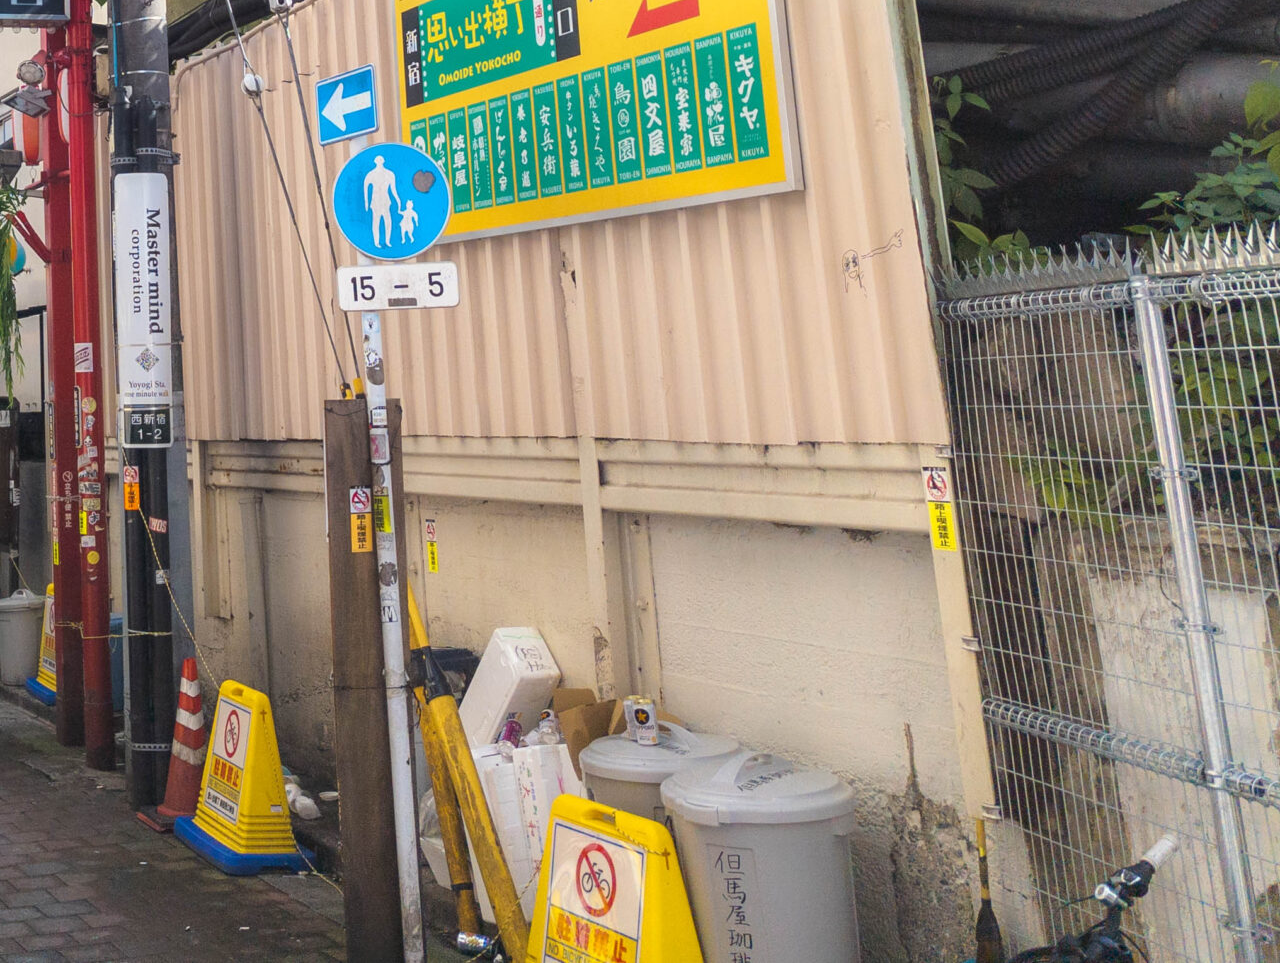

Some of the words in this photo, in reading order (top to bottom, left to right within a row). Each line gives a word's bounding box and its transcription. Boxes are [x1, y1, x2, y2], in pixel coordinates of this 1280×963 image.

[695, 36, 722, 50] BANPAIYA
[729, 28, 753, 40] KIKUYA
[406, 29, 421, 86] 新宿
[439, 64, 474, 86] OMOIDE
[475, 50, 522, 74] YOKOCHO
[610, 62, 631, 74] TORI-EN
[636, 53, 661, 67] SHIMONYA
[641, 74, 665, 156] 四文屋
[539, 105, 556, 176] 安兵衛
[742, 146, 764, 157] KIKUYA
[452, 134, 468, 187] 岐阜屋
[146, 208, 162, 277] Master
[131, 228, 142, 314] corporation
[351, 276, 376, 302] 15
[428, 272, 444, 297] 5
[148, 280, 163, 335] mind
[129, 380, 153, 390] Yoyogi
[131, 413, 166, 425] 西新宿
[138, 428, 162, 440] 1-2
